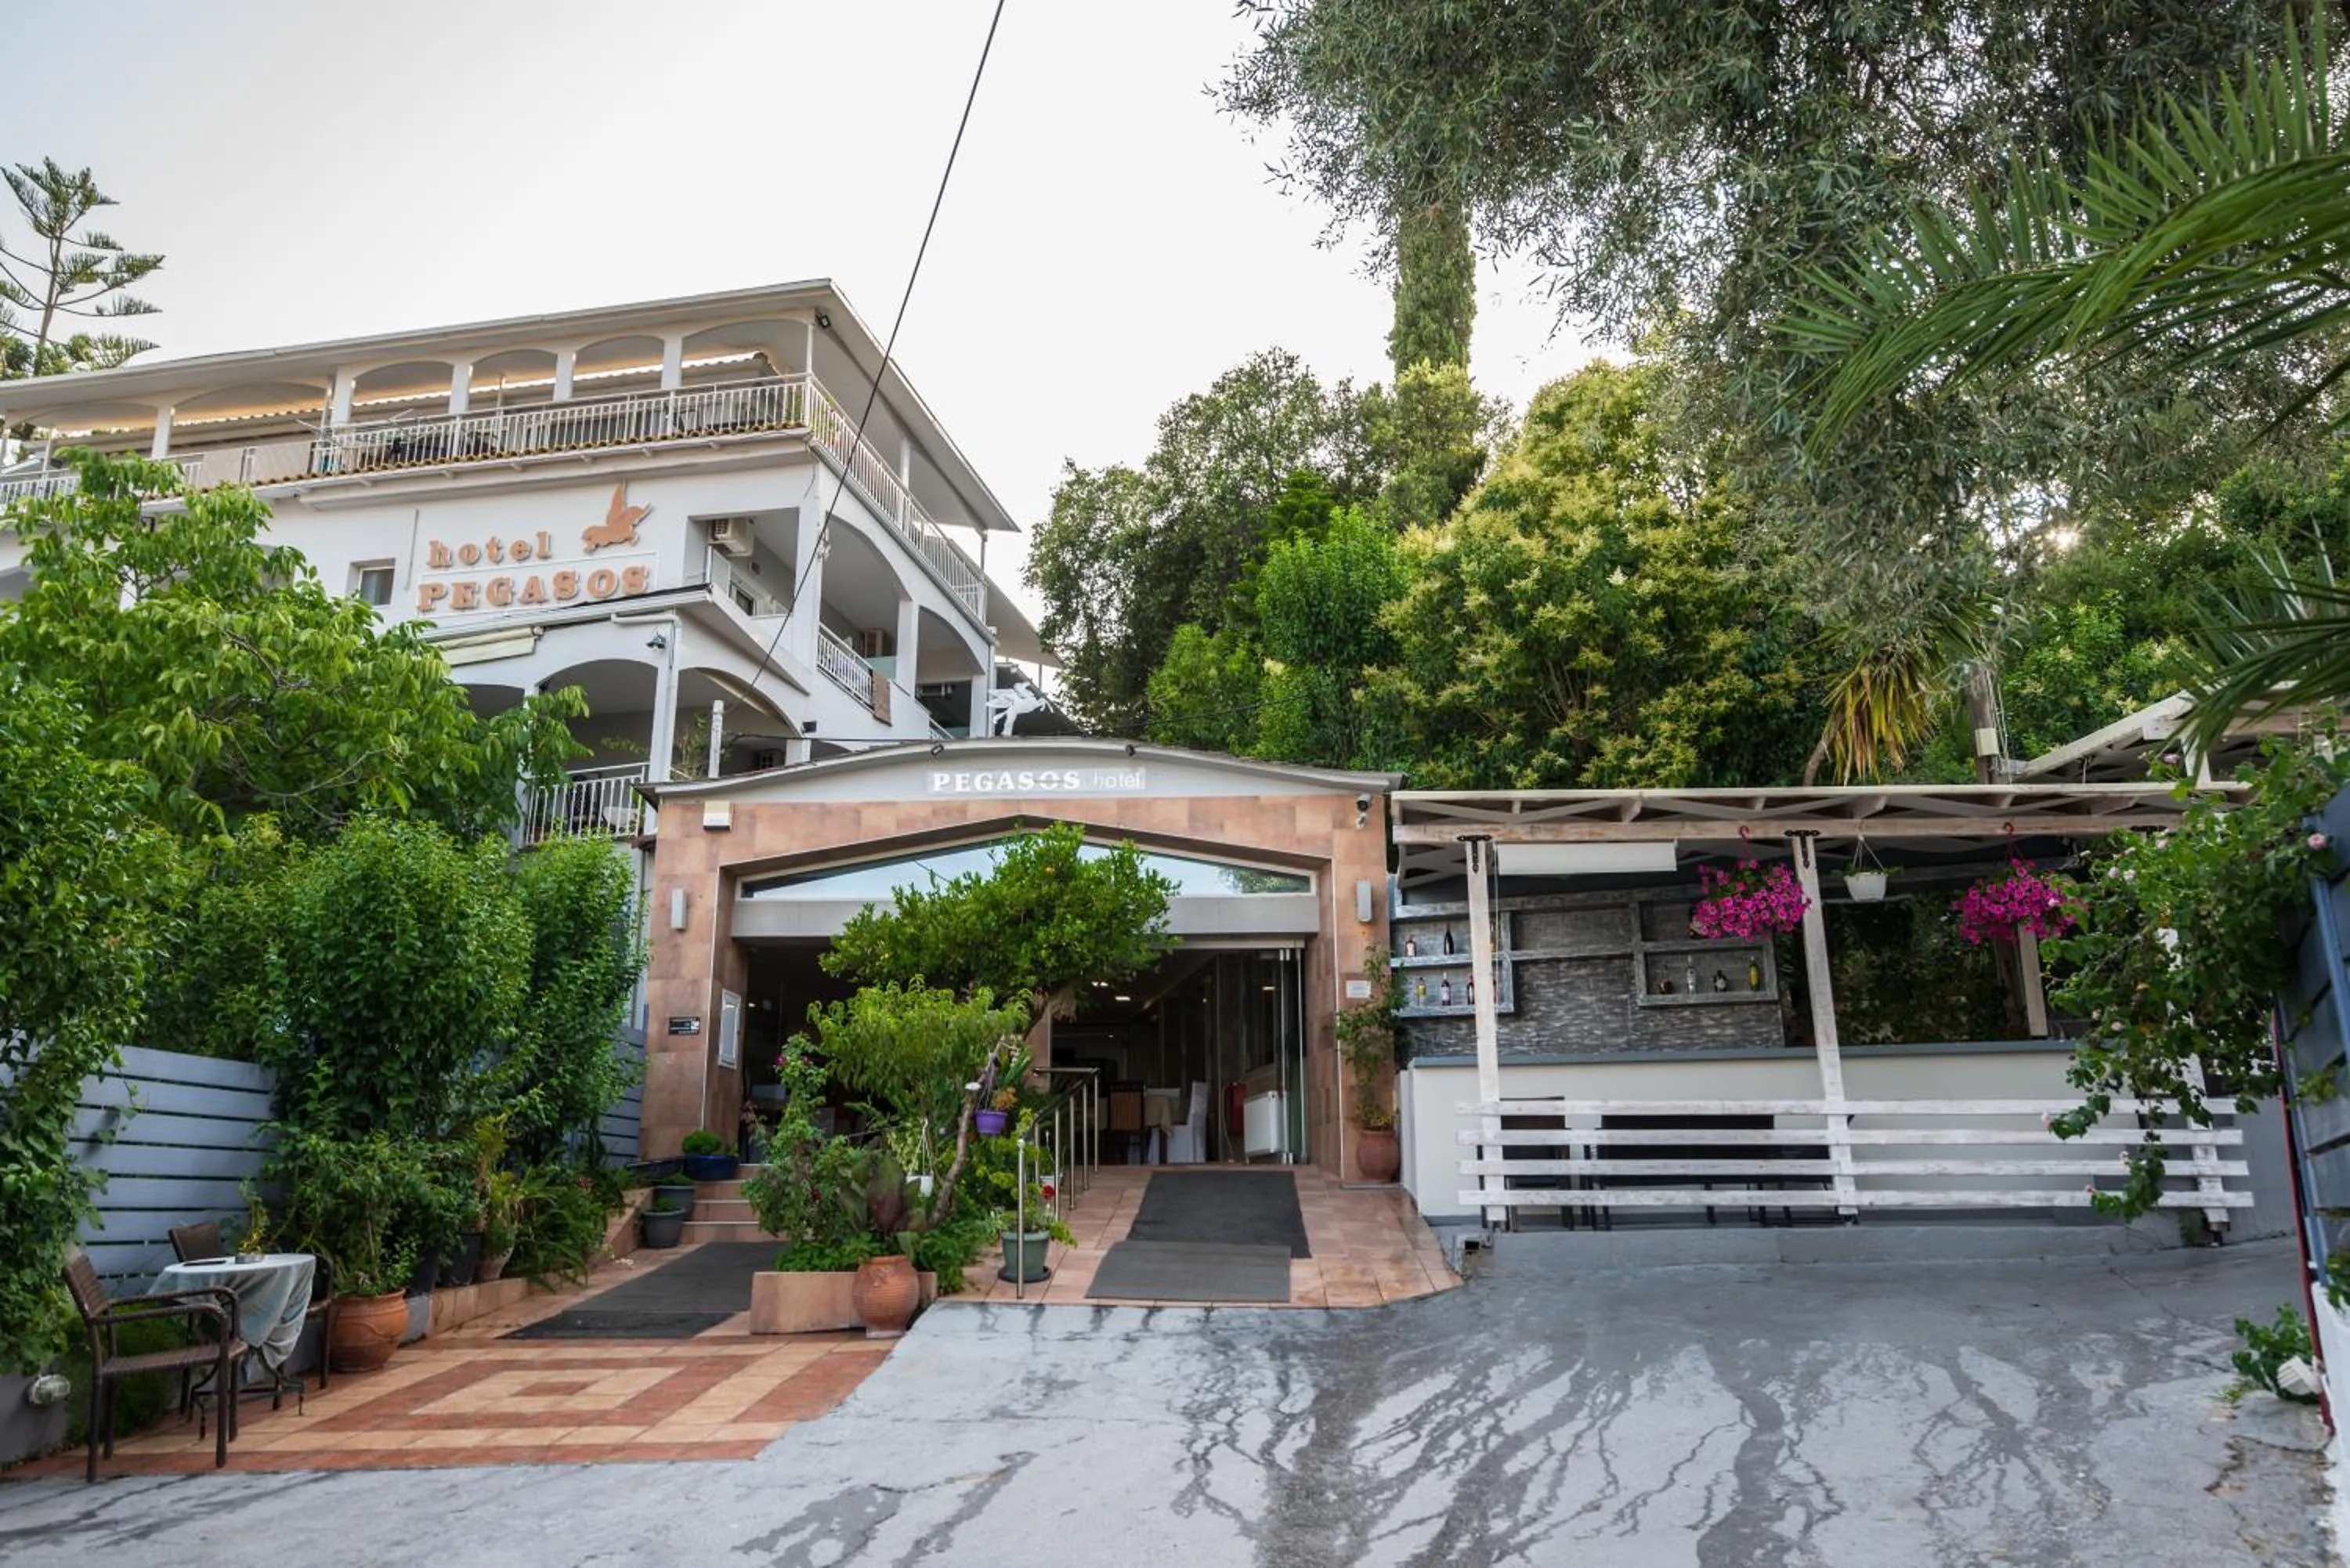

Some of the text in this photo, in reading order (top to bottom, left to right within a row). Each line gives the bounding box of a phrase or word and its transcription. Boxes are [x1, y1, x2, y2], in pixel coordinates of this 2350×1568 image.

[426, 531, 551, 569] hotel
[417, 564, 649, 612] PEGASOS
[933, 769, 1141, 792] PEGASOS hotel
